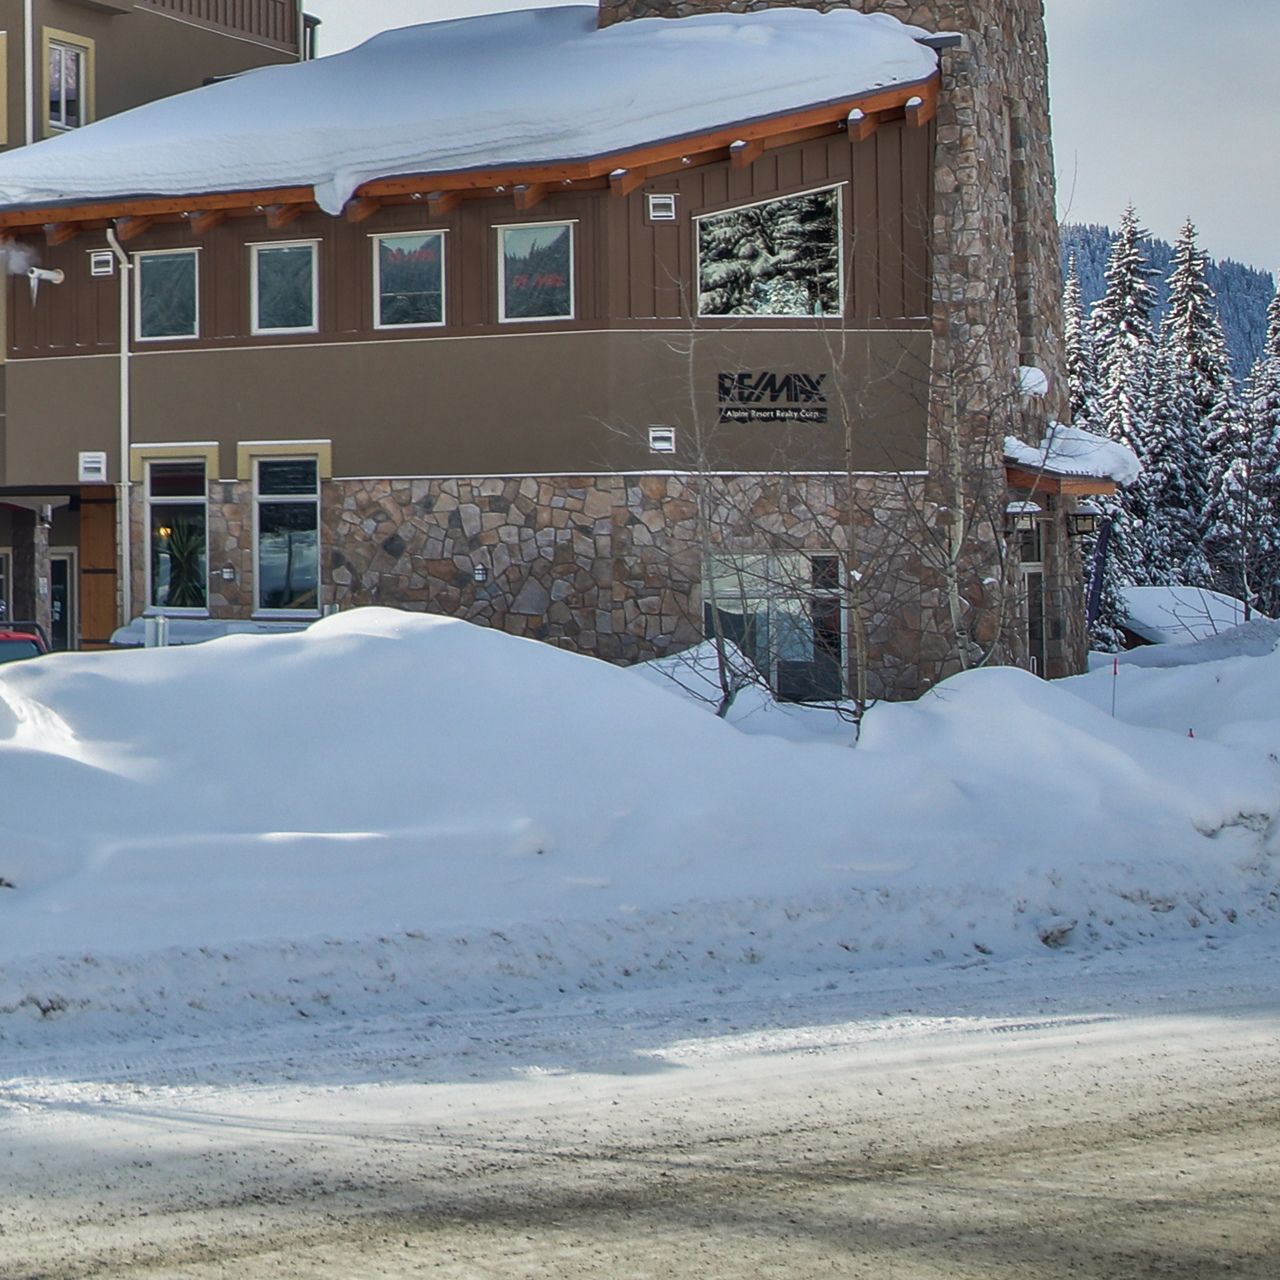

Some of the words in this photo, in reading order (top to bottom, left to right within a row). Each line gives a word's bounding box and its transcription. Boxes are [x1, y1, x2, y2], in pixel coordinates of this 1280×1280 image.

[718, 371, 827, 402] RE/MAX
[726, 409, 749, 418] Alpine
[751, 409, 774, 418] Resort
[776, 409, 798, 419] Realty
